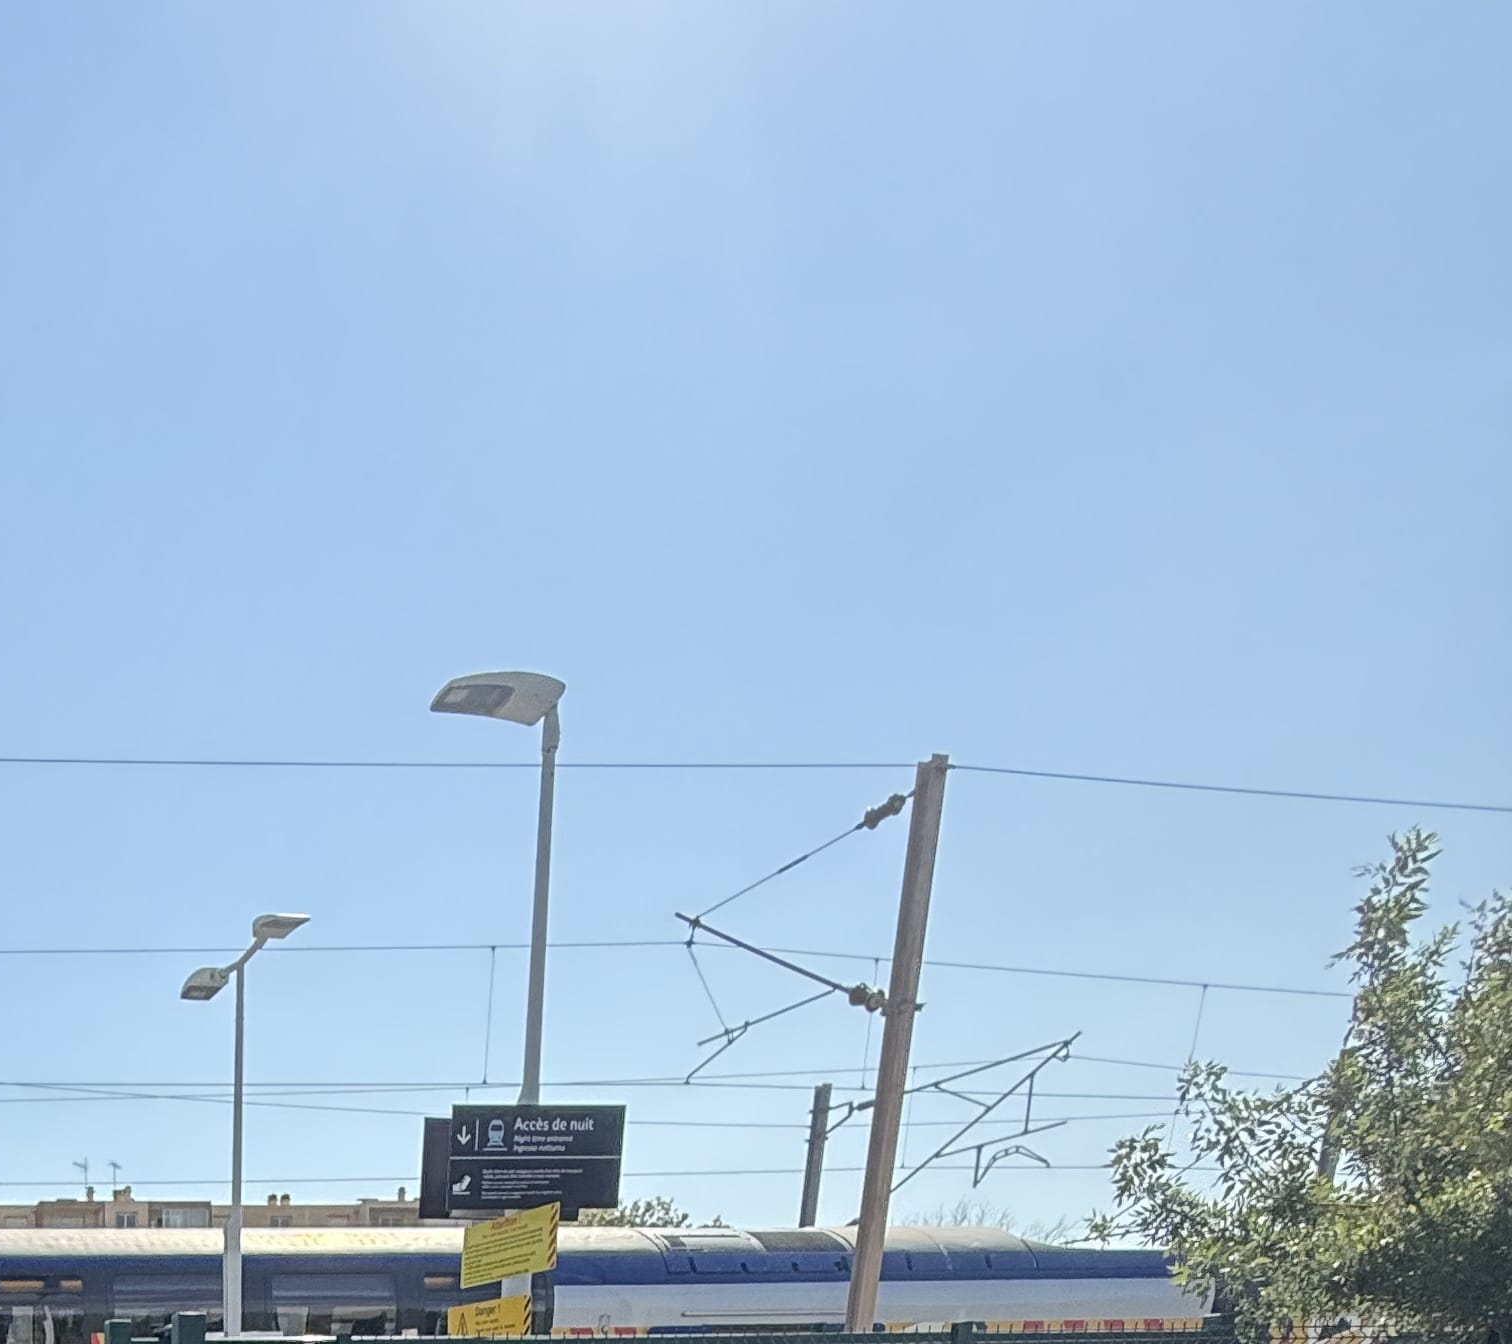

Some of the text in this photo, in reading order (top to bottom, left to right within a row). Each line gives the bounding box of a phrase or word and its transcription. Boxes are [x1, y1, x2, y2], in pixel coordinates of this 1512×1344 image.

[514, 1116, 594, 1131] Accès de nuit
